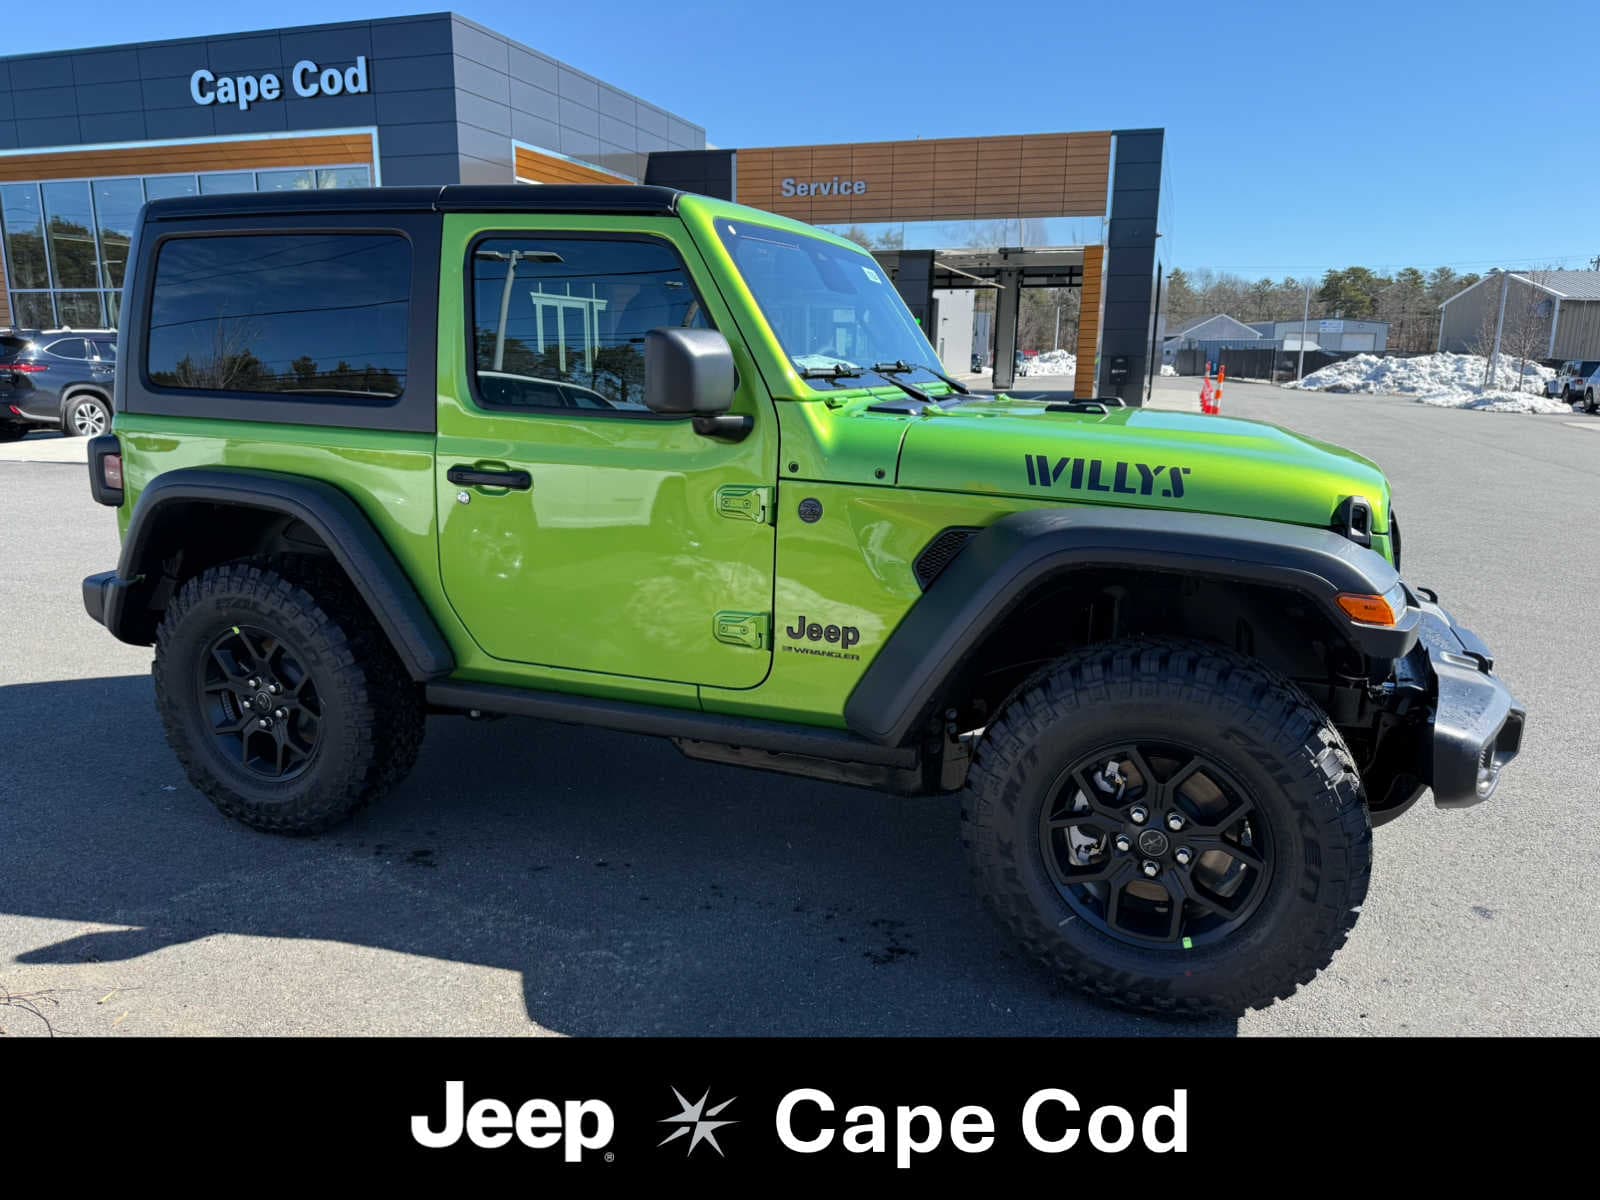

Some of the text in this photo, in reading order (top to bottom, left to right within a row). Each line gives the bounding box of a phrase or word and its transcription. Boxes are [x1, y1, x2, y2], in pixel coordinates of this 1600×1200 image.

[190, 55, 368, 110] Cape Cod
[782, 176, 867, 198] Service
[1025, 454, 1191, 498] WILLYS
[786, 615, 860, 649] Jeep
[794, 646, 860, 661] WRANGLER
